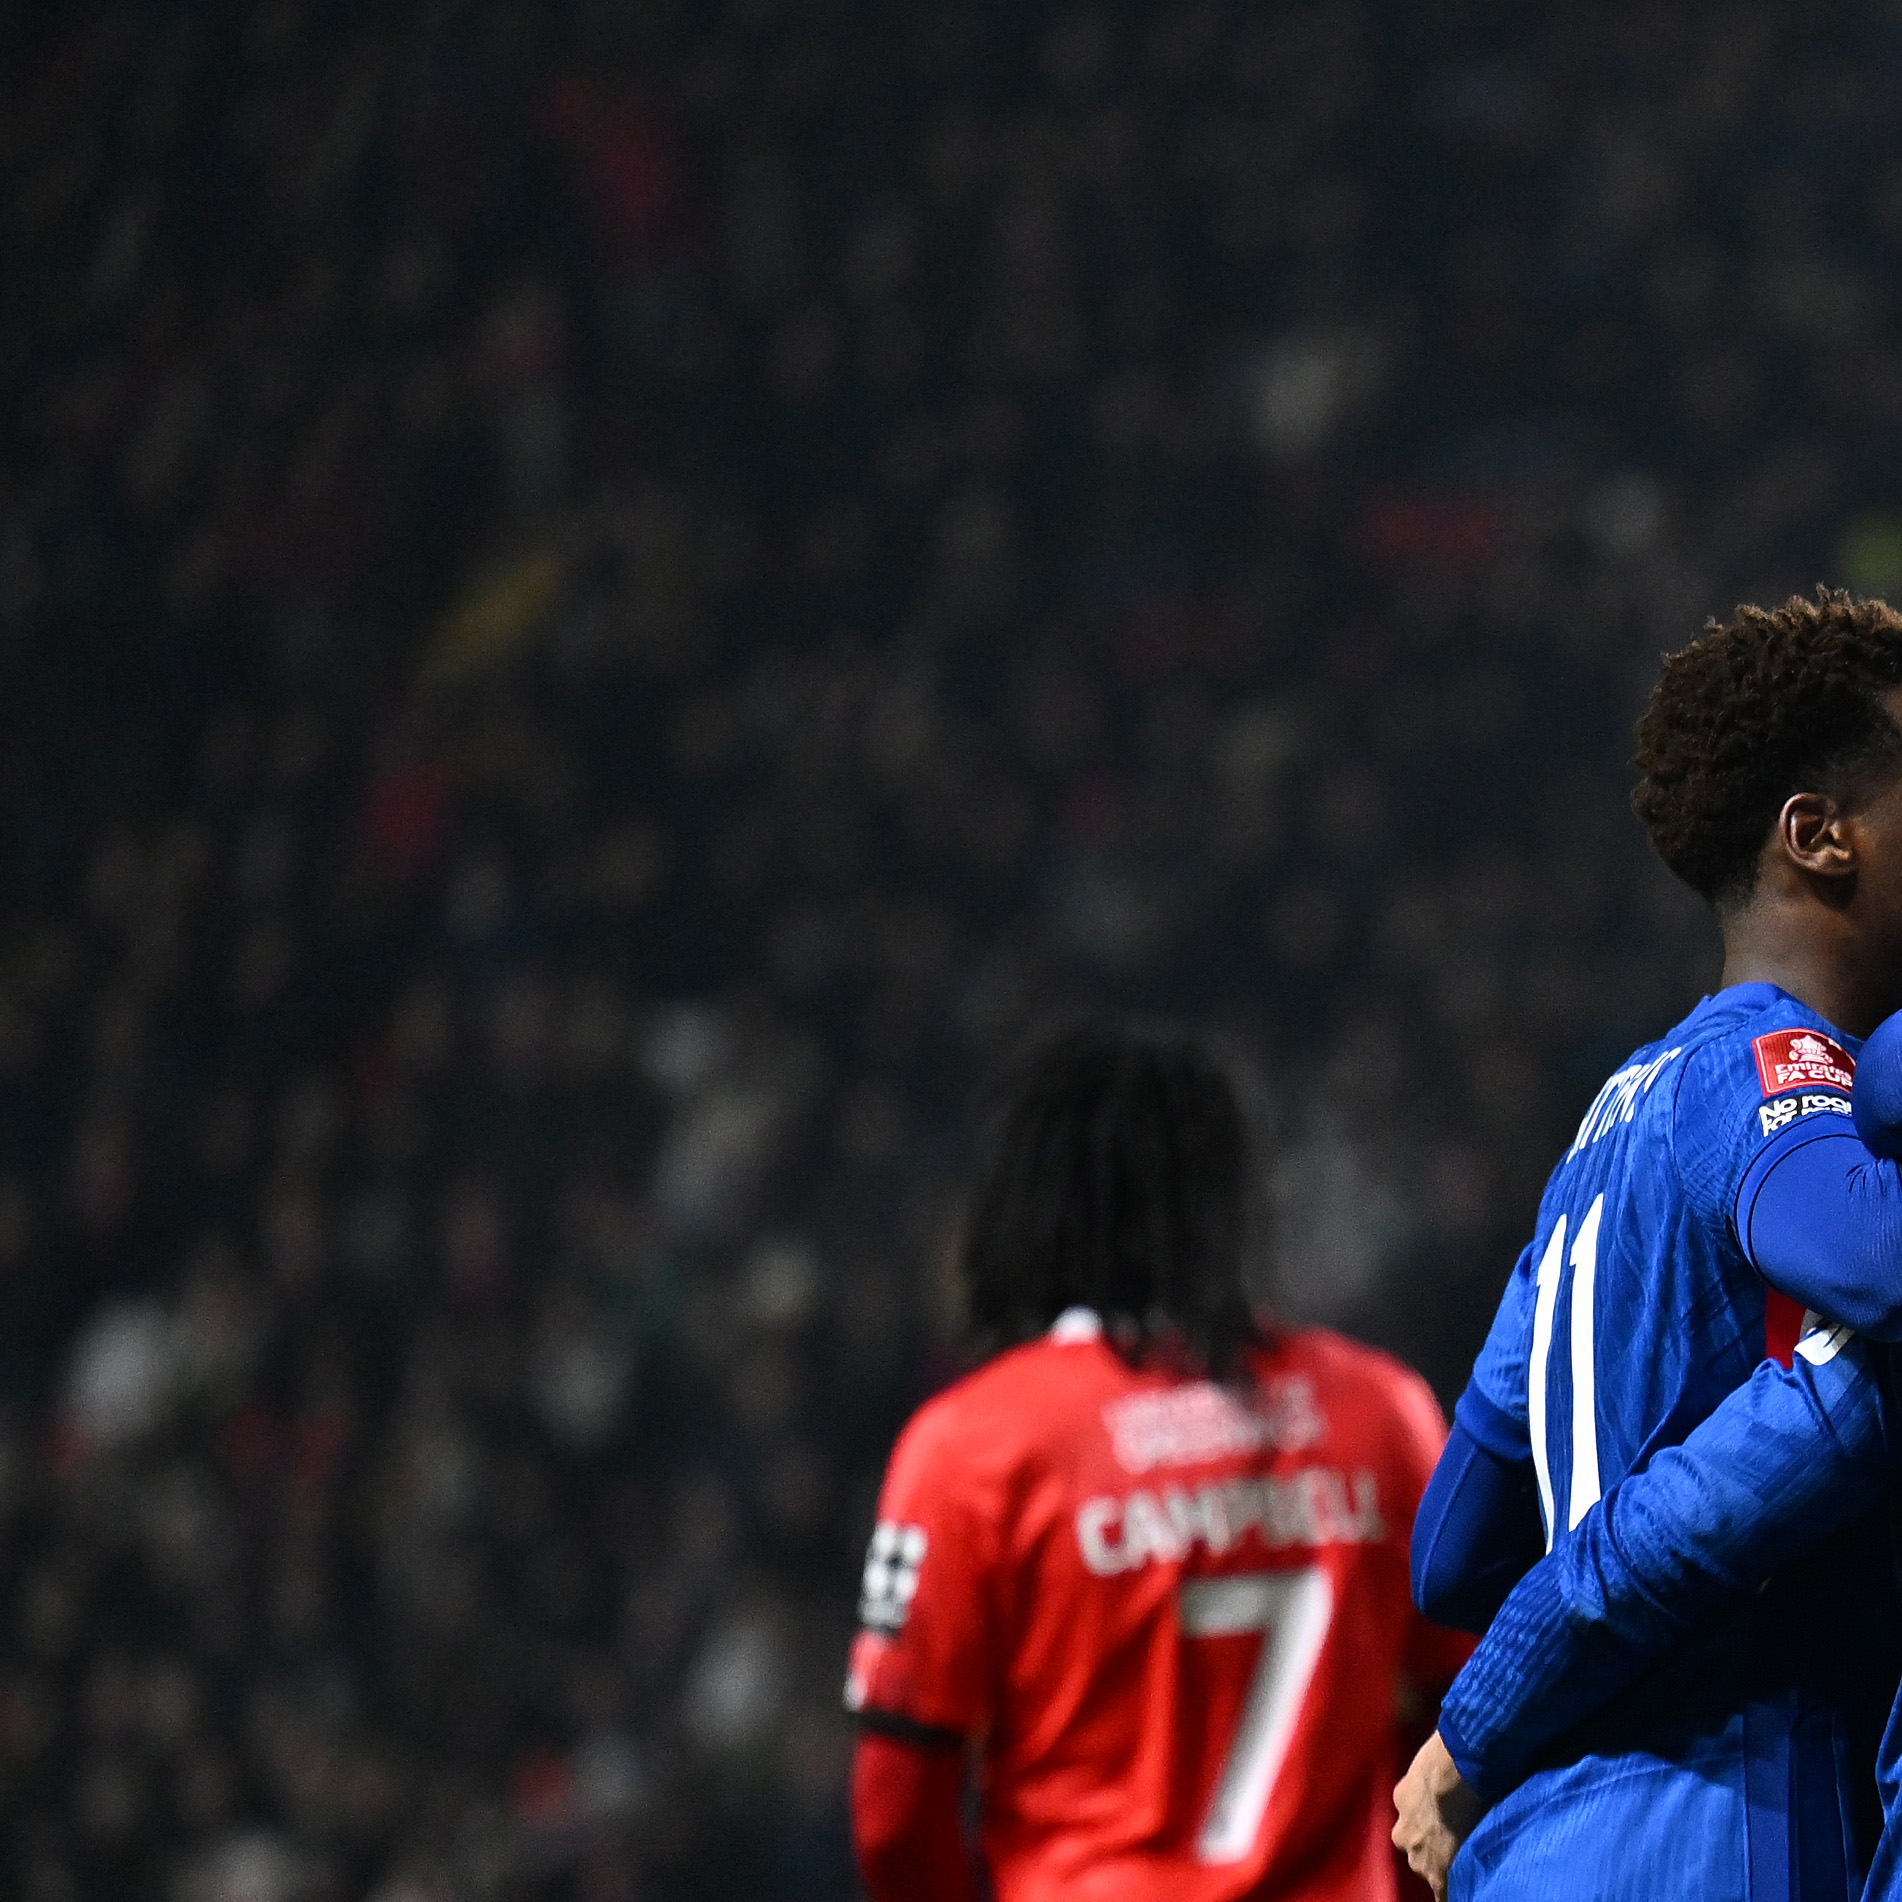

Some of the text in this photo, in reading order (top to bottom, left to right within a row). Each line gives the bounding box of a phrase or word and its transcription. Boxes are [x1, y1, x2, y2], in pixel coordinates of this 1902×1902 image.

[1777, 1070, 1853, 1087] FA CUP
[1527, 1193, 1603, 1557] 11
[1178, 1566, 1336, 1866] 7
